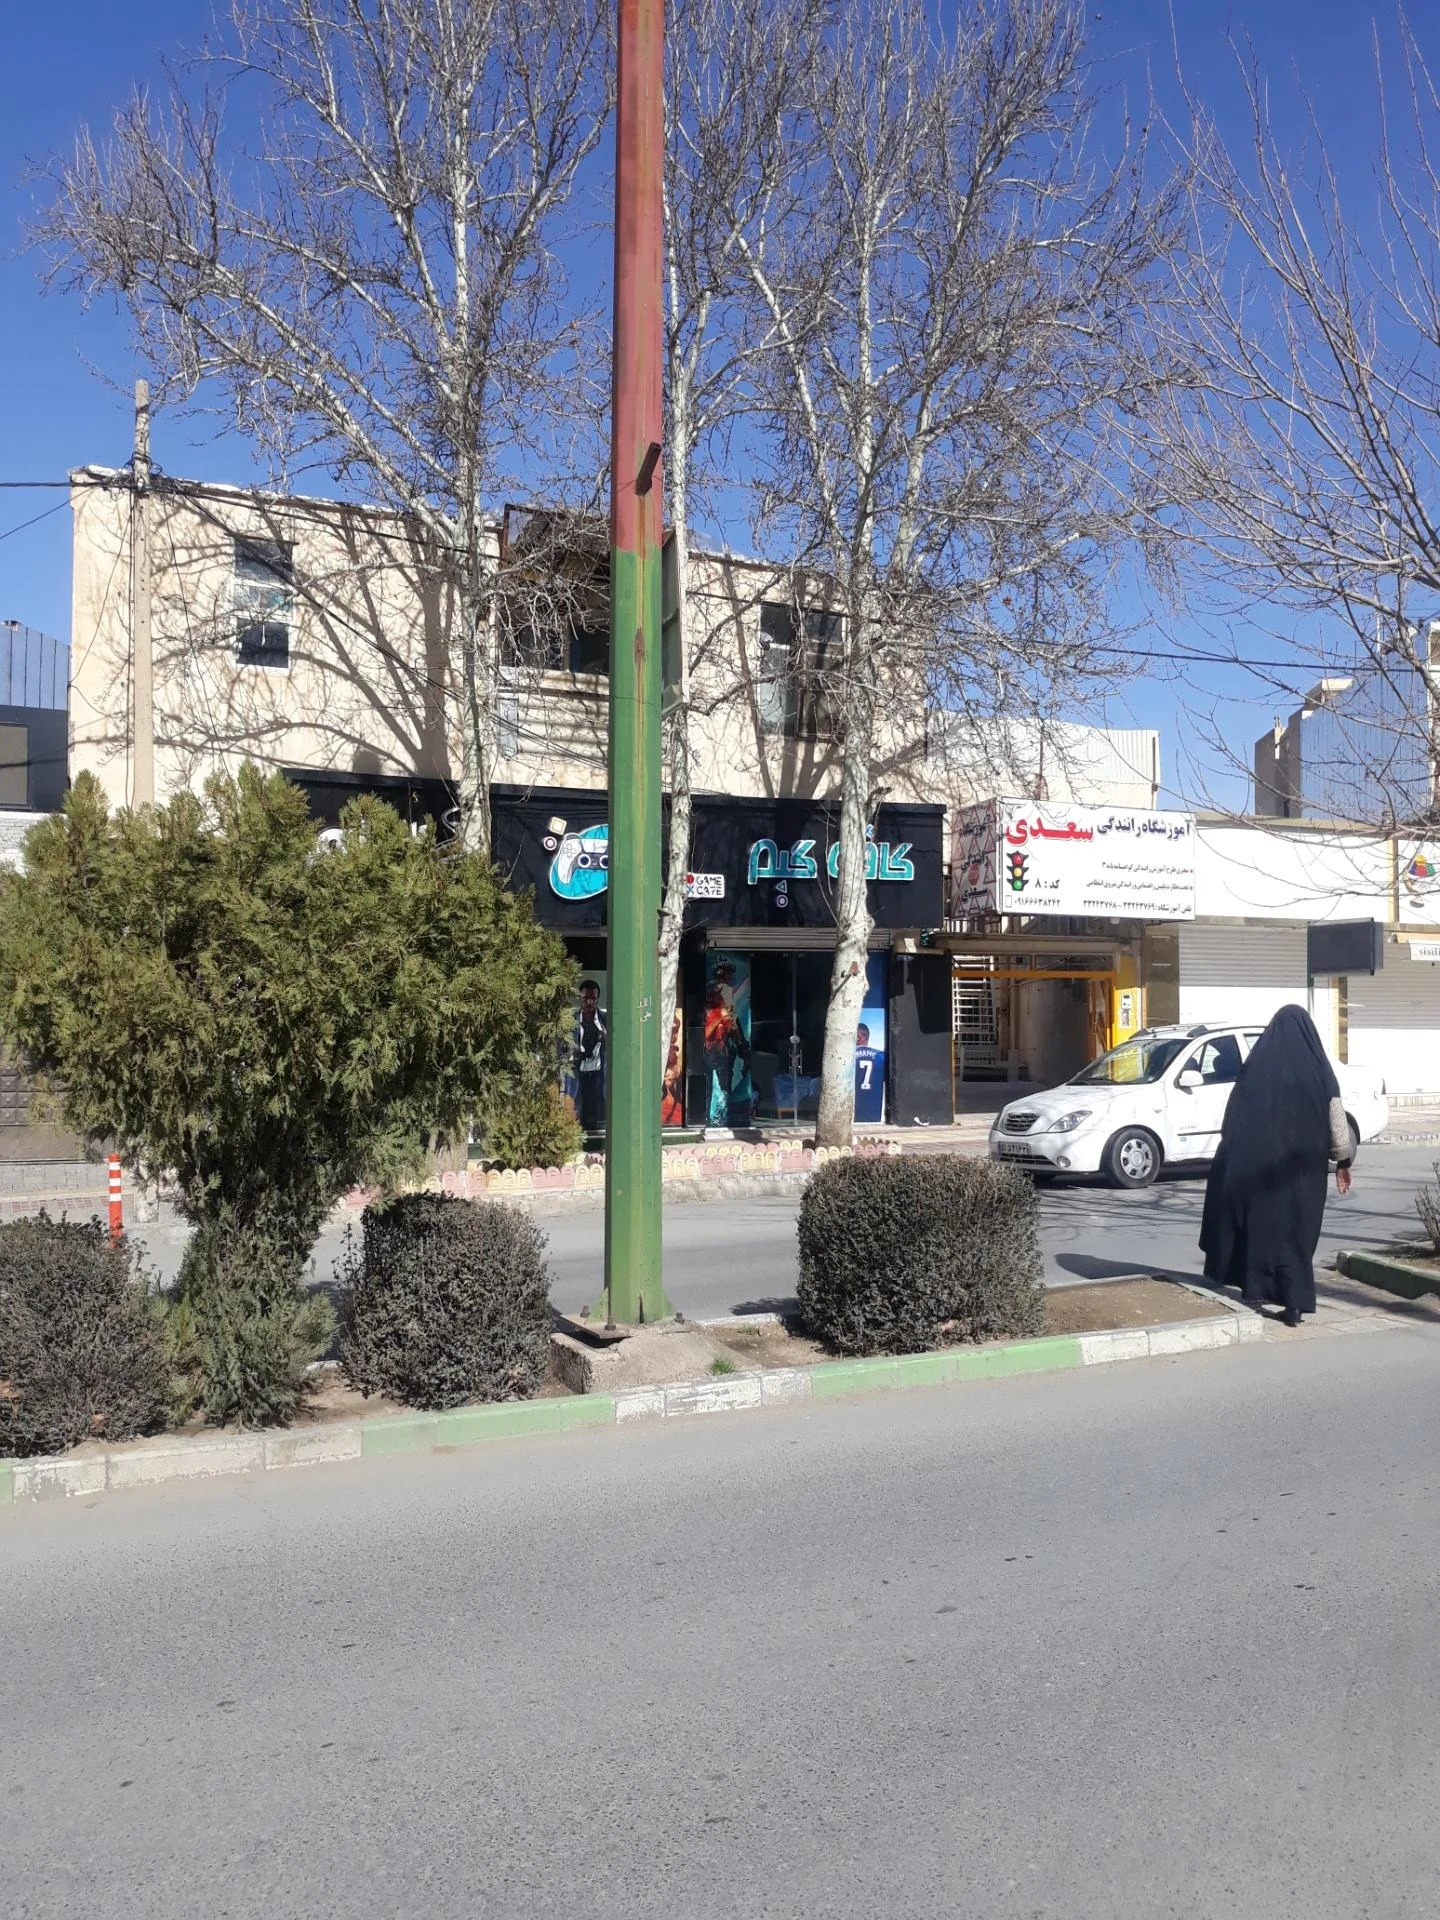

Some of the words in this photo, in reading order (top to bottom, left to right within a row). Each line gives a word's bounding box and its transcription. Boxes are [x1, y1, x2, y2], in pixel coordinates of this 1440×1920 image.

[1006, 817, 1094, 846] سعدی
[1097, 815, 1141, 838] رانندگی
[1141, 818, 1191, 841] آموزشگاه
[696, 876, 722, 886] GAME
[697, 886, 723, 896] CAFE
[1035, 877, 1042, 889] ۸
[859, 1060, 873, 1090] 7
